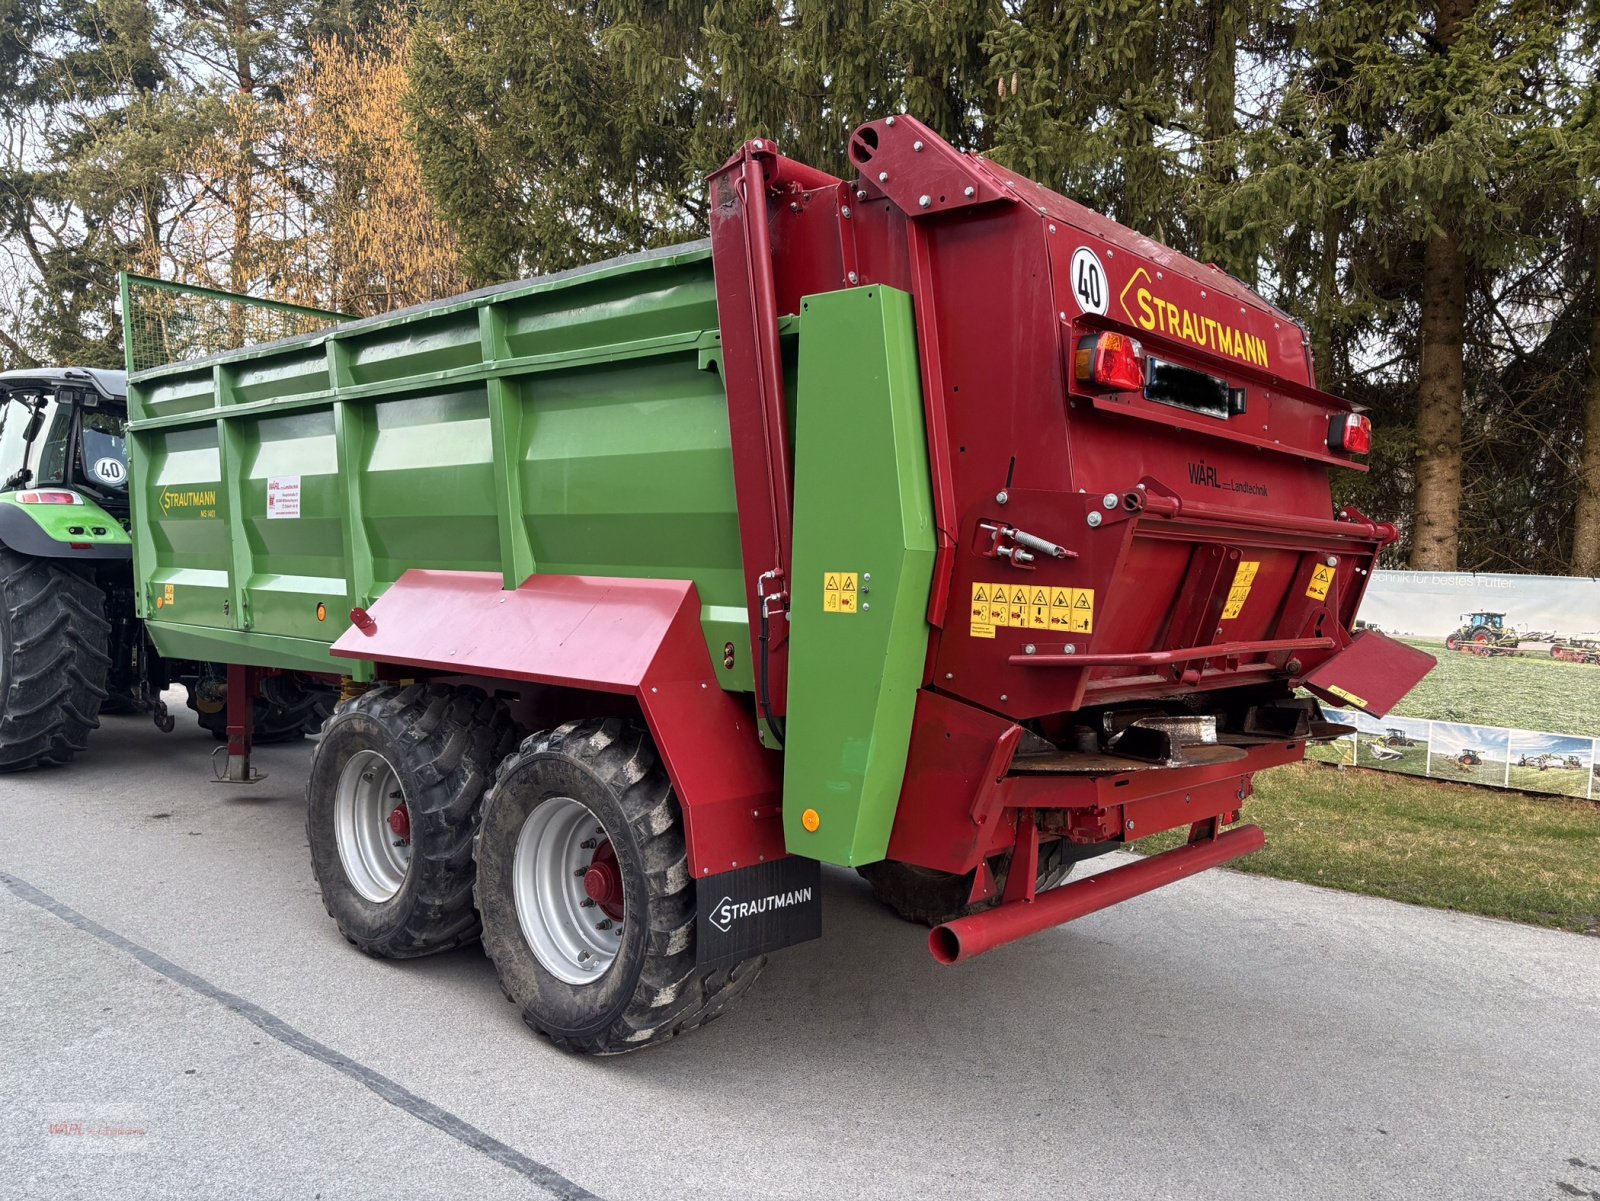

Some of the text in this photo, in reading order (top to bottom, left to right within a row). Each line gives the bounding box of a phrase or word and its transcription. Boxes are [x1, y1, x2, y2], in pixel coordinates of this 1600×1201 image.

[1077, 258, 1101, 308] 40
[1137, 287, 1269, 368] STRAUTMANN
[101, 462, 120, 478] 40
[1187, 459, 1268, 497] WÄRL Landtechnik
[164, 490, 216, 509] STRAUTMANN
[1371, 572, 1516, 589] echnik für bestes Futter.
[720, 887, 812, 924] STRAUTMANN
